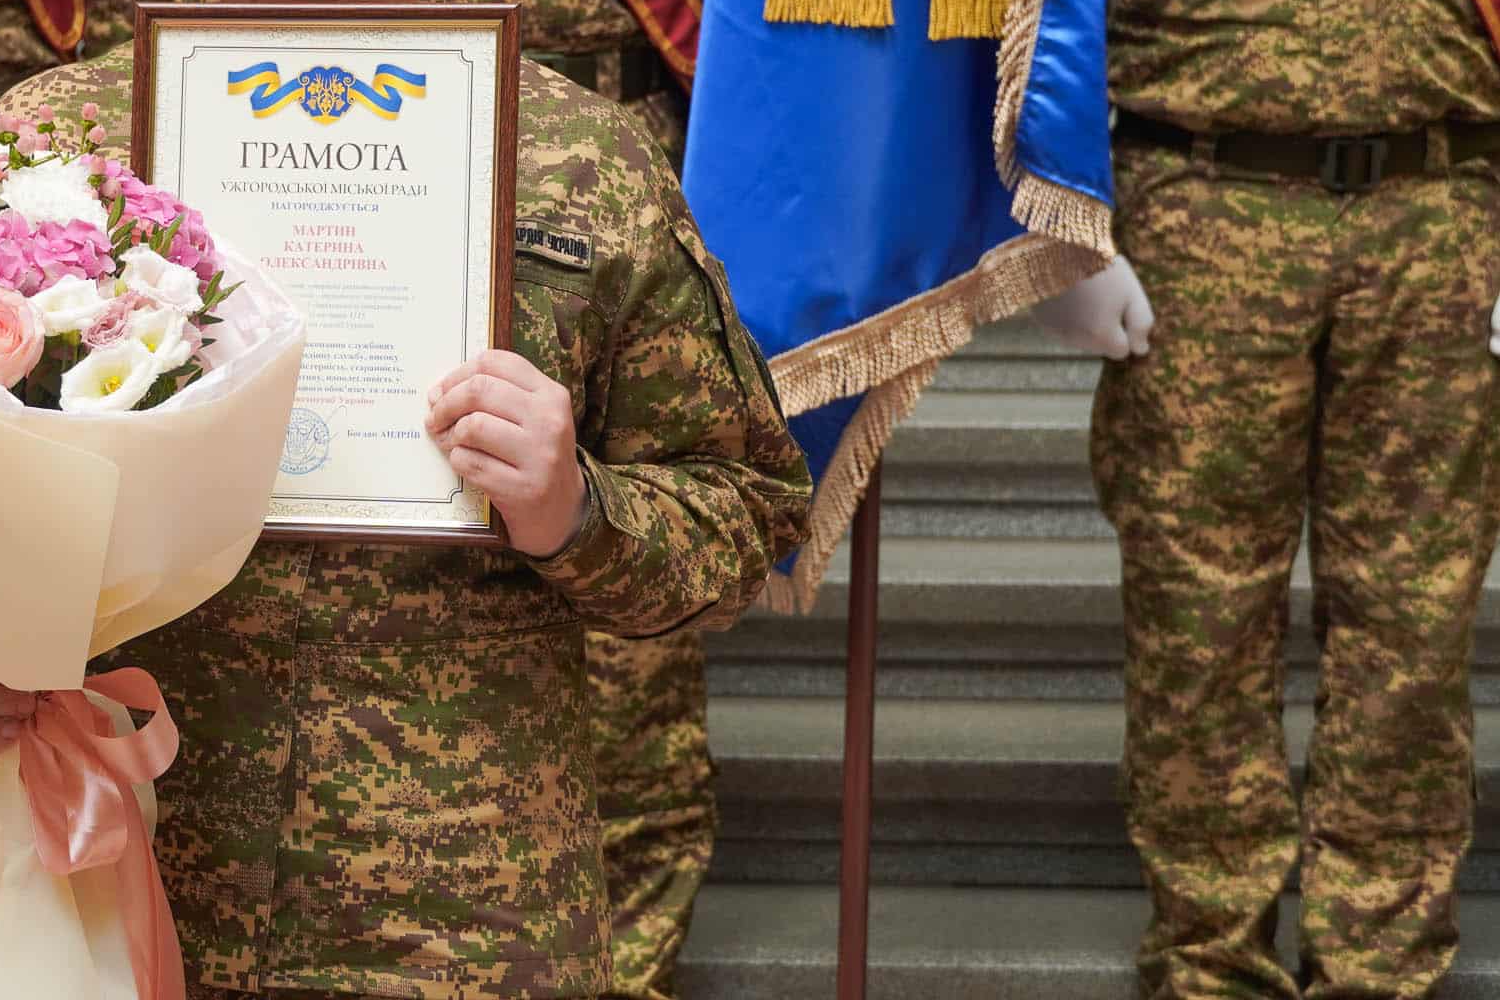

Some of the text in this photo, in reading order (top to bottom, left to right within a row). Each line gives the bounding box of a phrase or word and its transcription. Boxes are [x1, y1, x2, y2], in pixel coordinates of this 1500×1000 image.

[239, 142, 408, 171] ГРАМОТА
[293, 225, 356, 237] МАРТИН
[284, 241, 364, 254] КАТЕРИНА
